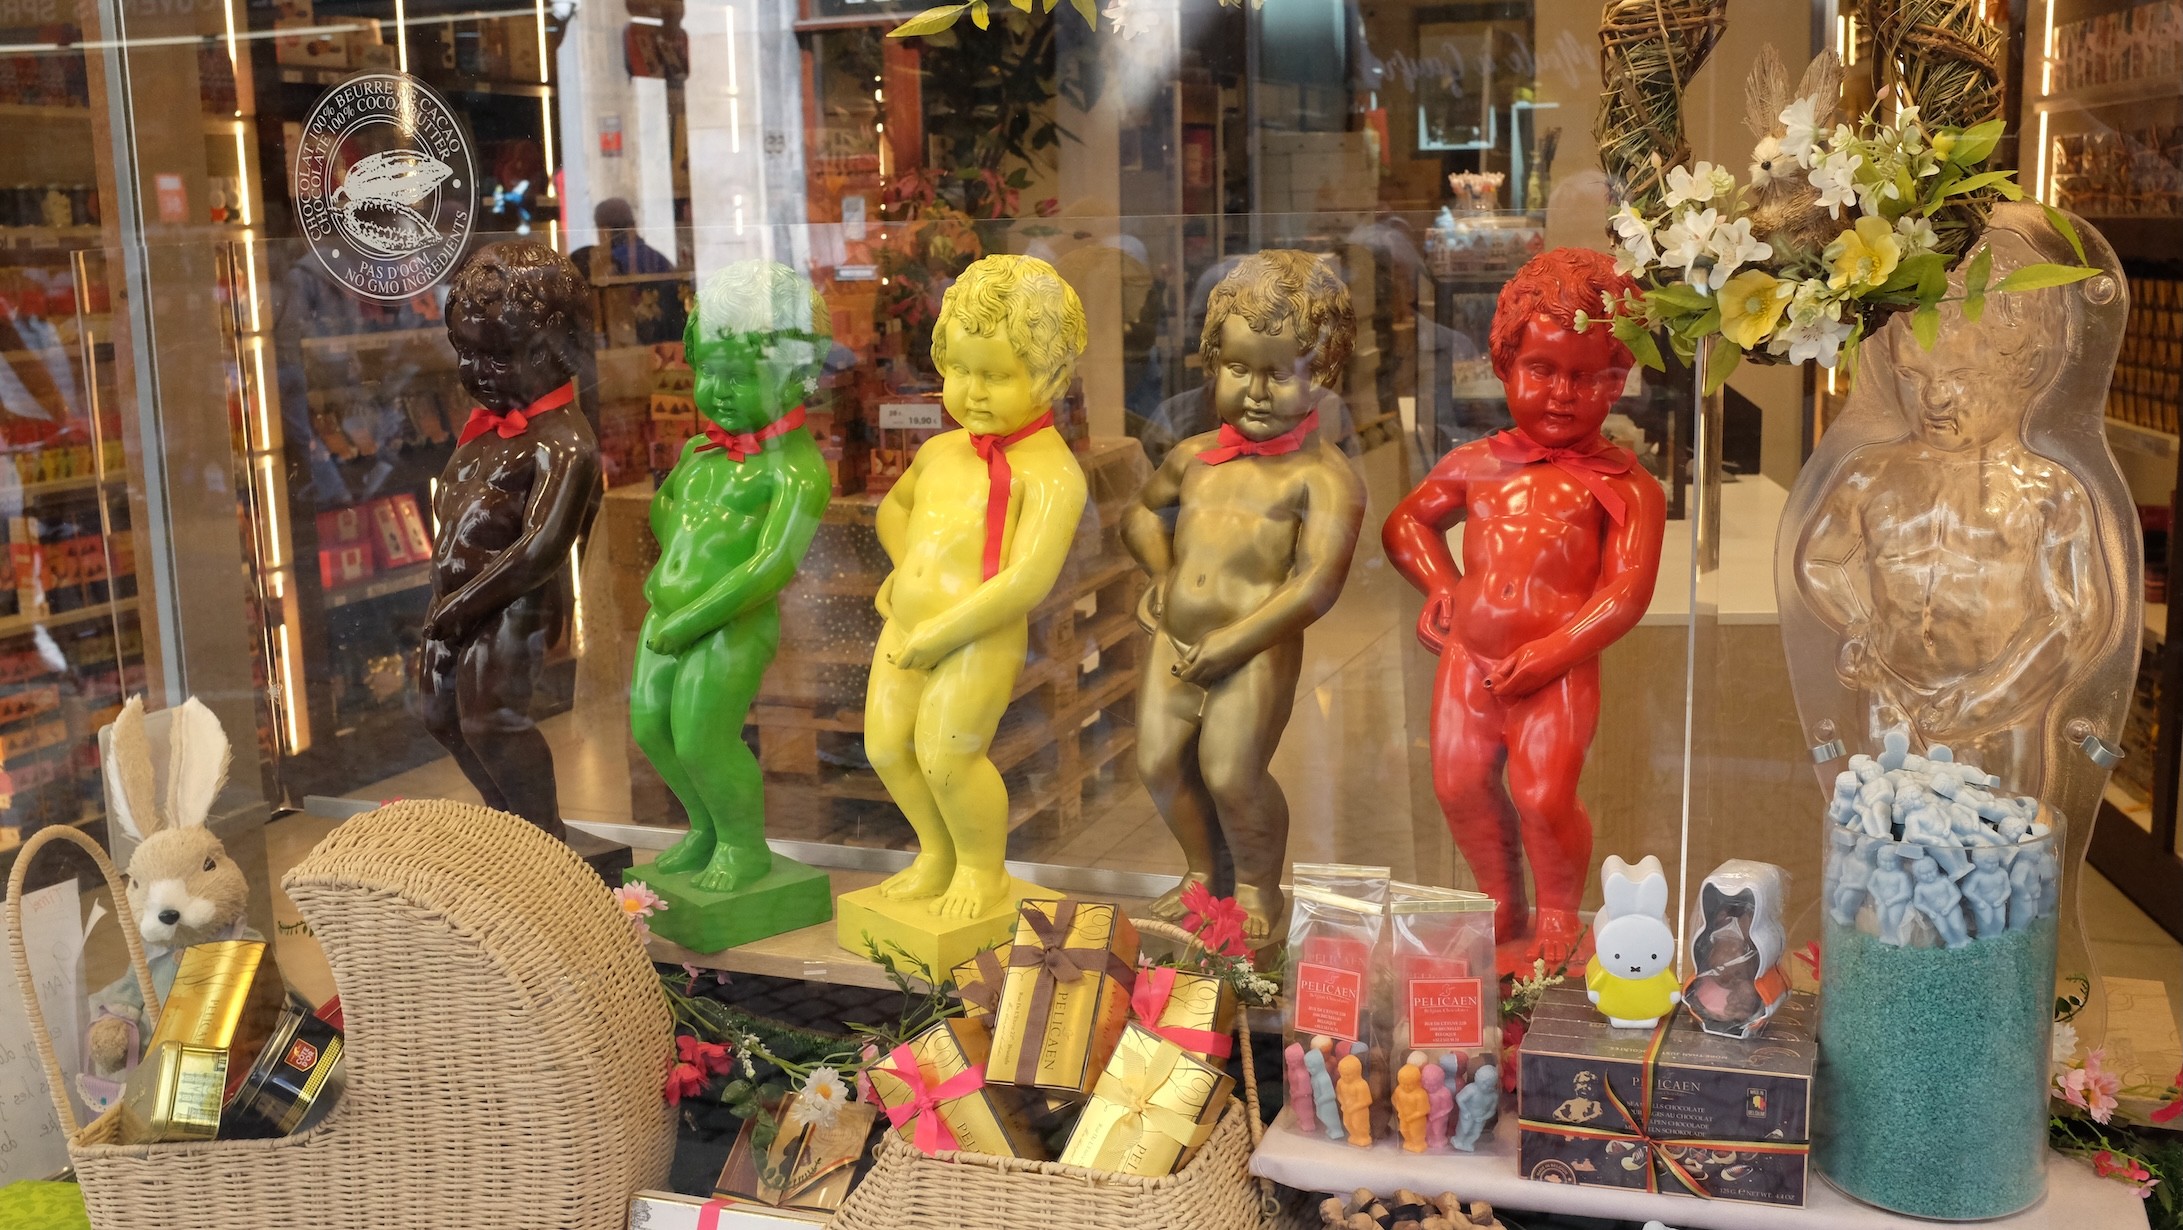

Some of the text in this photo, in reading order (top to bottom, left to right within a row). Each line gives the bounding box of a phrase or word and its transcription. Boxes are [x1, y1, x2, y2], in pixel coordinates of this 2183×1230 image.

[298, 81, 460, 242] CHOCOLAT 100% BEURRE DE CACAO
[309, 96, 451, 235] CHOCOLATE 100% COCOA BUTTER
[345, 209, 468, 294] NO GMO INGREDIENTS
[360, 251, 431, 279] PAS D'OGM
[1301, 979, 1358, 999] PELICAEN
[1414, 996, 1477, 1006] PELICAEN
[1043, 992, 1068, 1070] PELICAEN
[1632, 1076, 1701, 1091] PICAEN
[1664, 1104, 1705, 1113] CHOCOLATE
[1676, 1113, 1713, 1121] CHOCOLAT
[1662, 1128, 1706, 1137] SCHOKOLADE
[1667, 1120, 1709, 1130] CHOCOLADE
